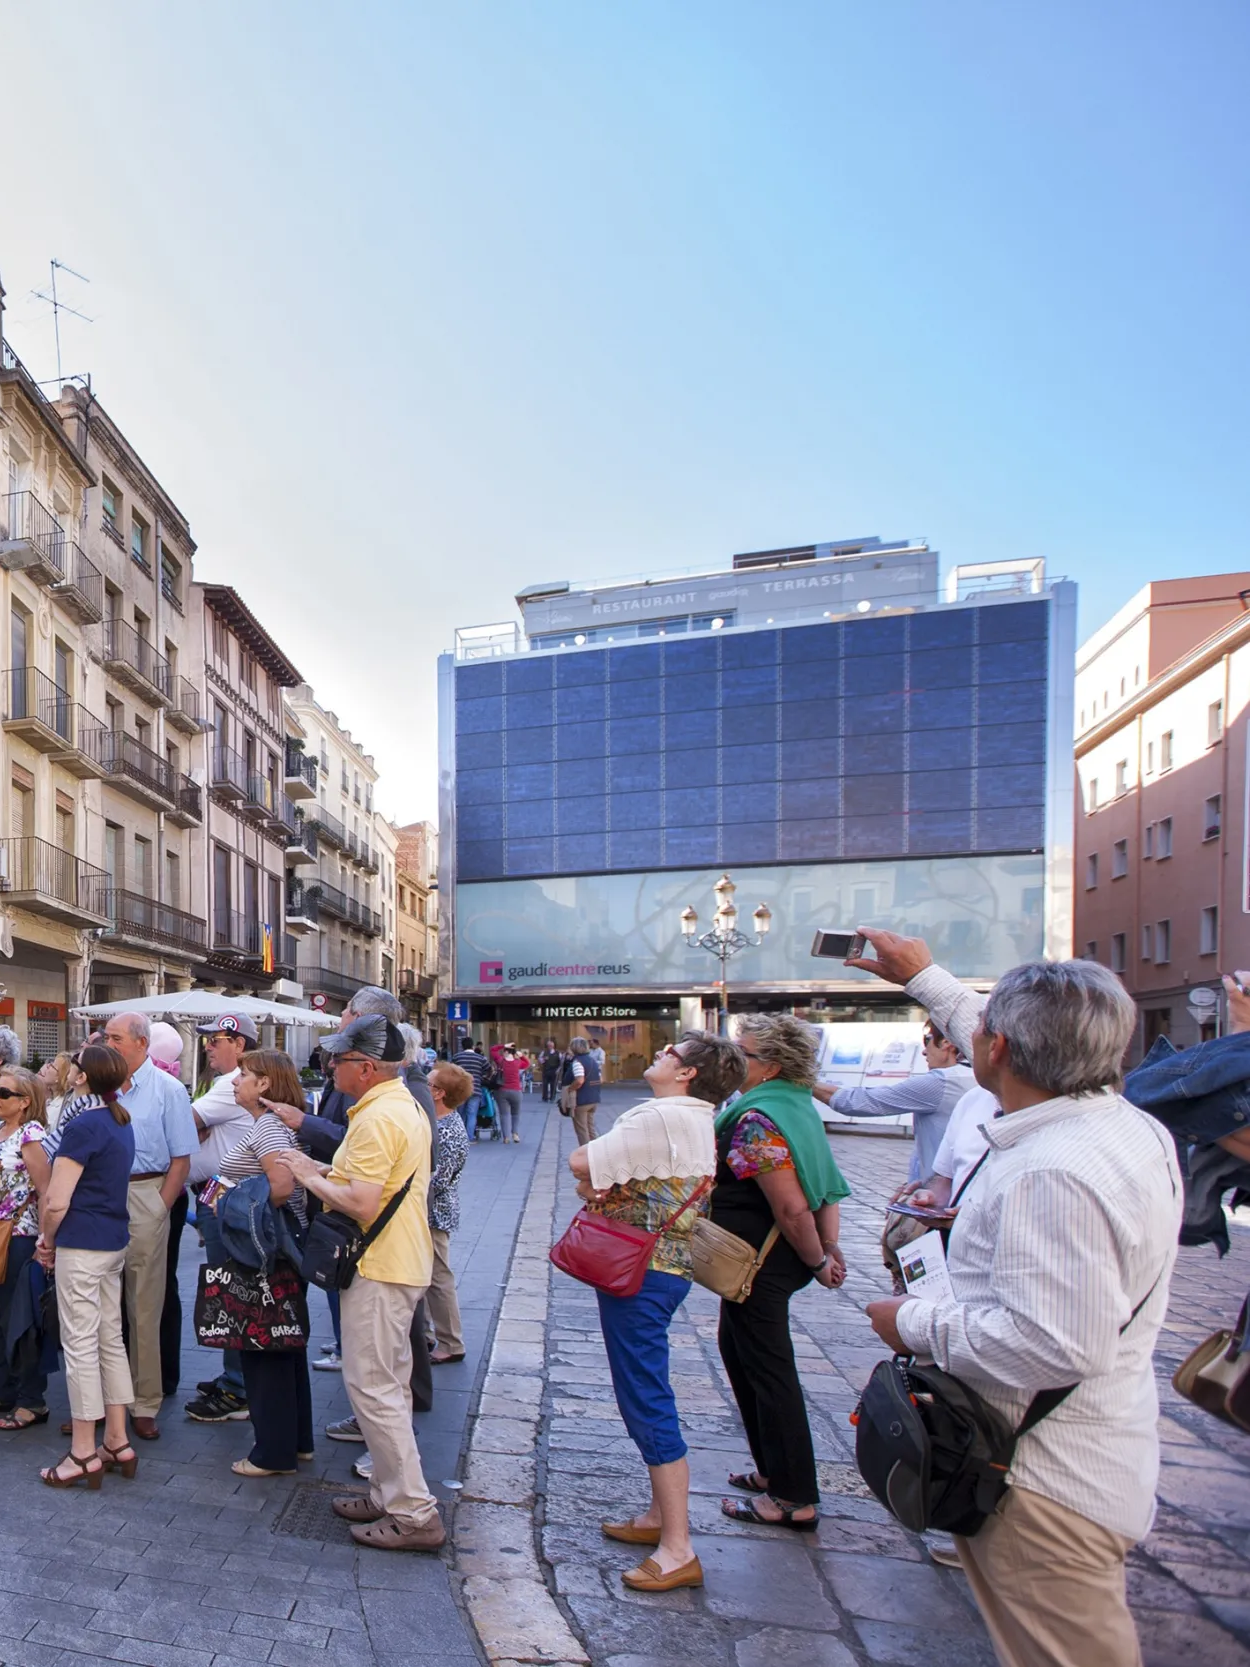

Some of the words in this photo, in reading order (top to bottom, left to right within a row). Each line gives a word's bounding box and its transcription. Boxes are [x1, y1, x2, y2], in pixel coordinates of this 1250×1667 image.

[592, 592, 697, 614] RESTAURANT
[762, 573, 855, 593] TERRASSA
[545, 1007, 599, 1017] INTECAT
[601, 1006, 637, 1017] iStore
